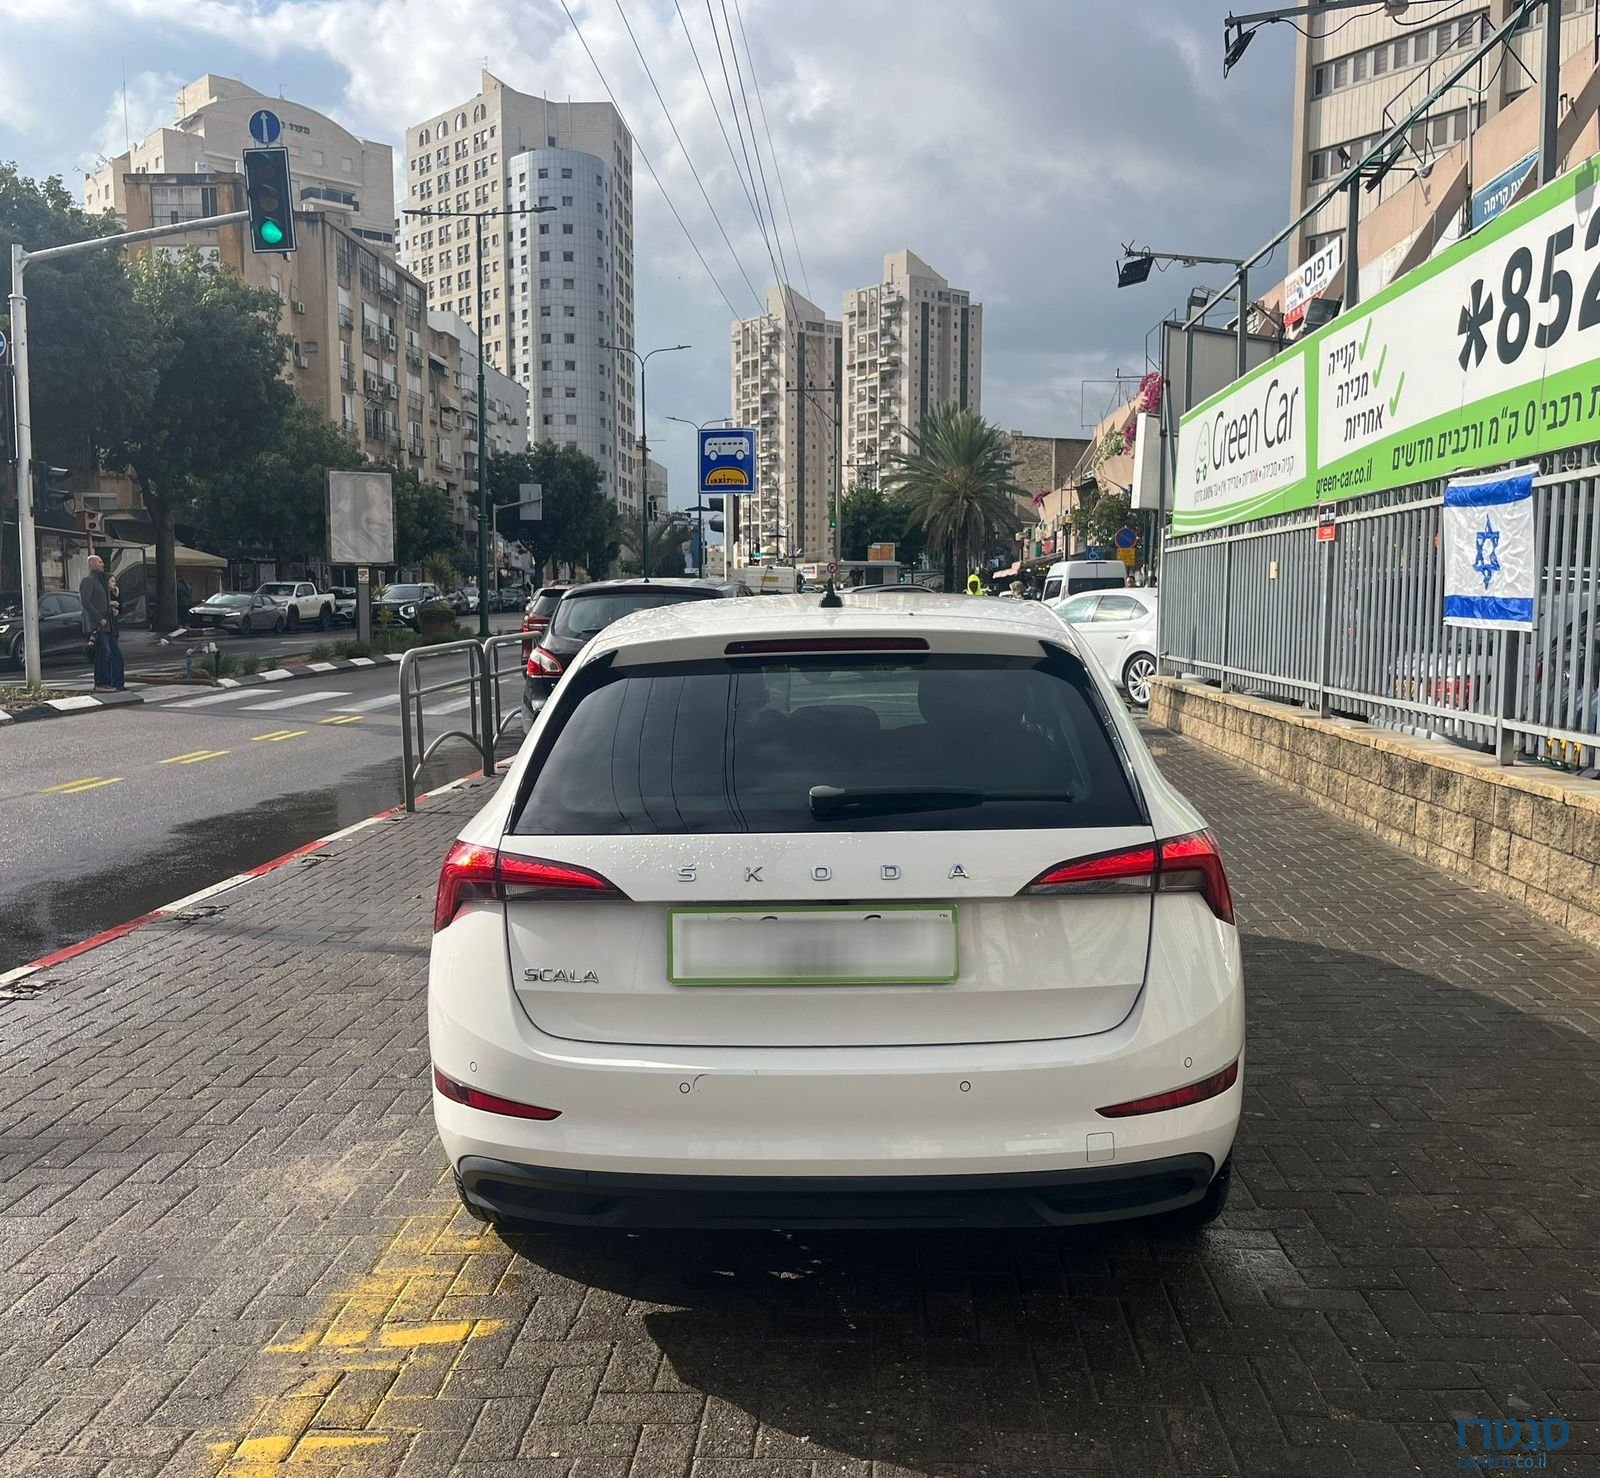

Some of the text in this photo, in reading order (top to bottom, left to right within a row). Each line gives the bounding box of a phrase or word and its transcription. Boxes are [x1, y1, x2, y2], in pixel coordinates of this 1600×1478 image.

[1304, 249, 1333, 288] דפוס
[1328, 340, 1356, 376] קנייה
[1336, 371, 1369, 408] מכירה
[1212, 379, 1299, 470] Green Car
[1344, 404, 1384, 442] אחריות
[1525, 400, 1536, 436] 0
[1541, 392, 1582, 431] רכבי
[1392, 436, 1434, 471] חדשים
[1437, 421, 1484, 458] ורכבים
[1315, 457, 1373, 500] green-car.co.il
[677, 863, 970, 883] ŠKODA
[524, 967, 600, 984] SCALA
